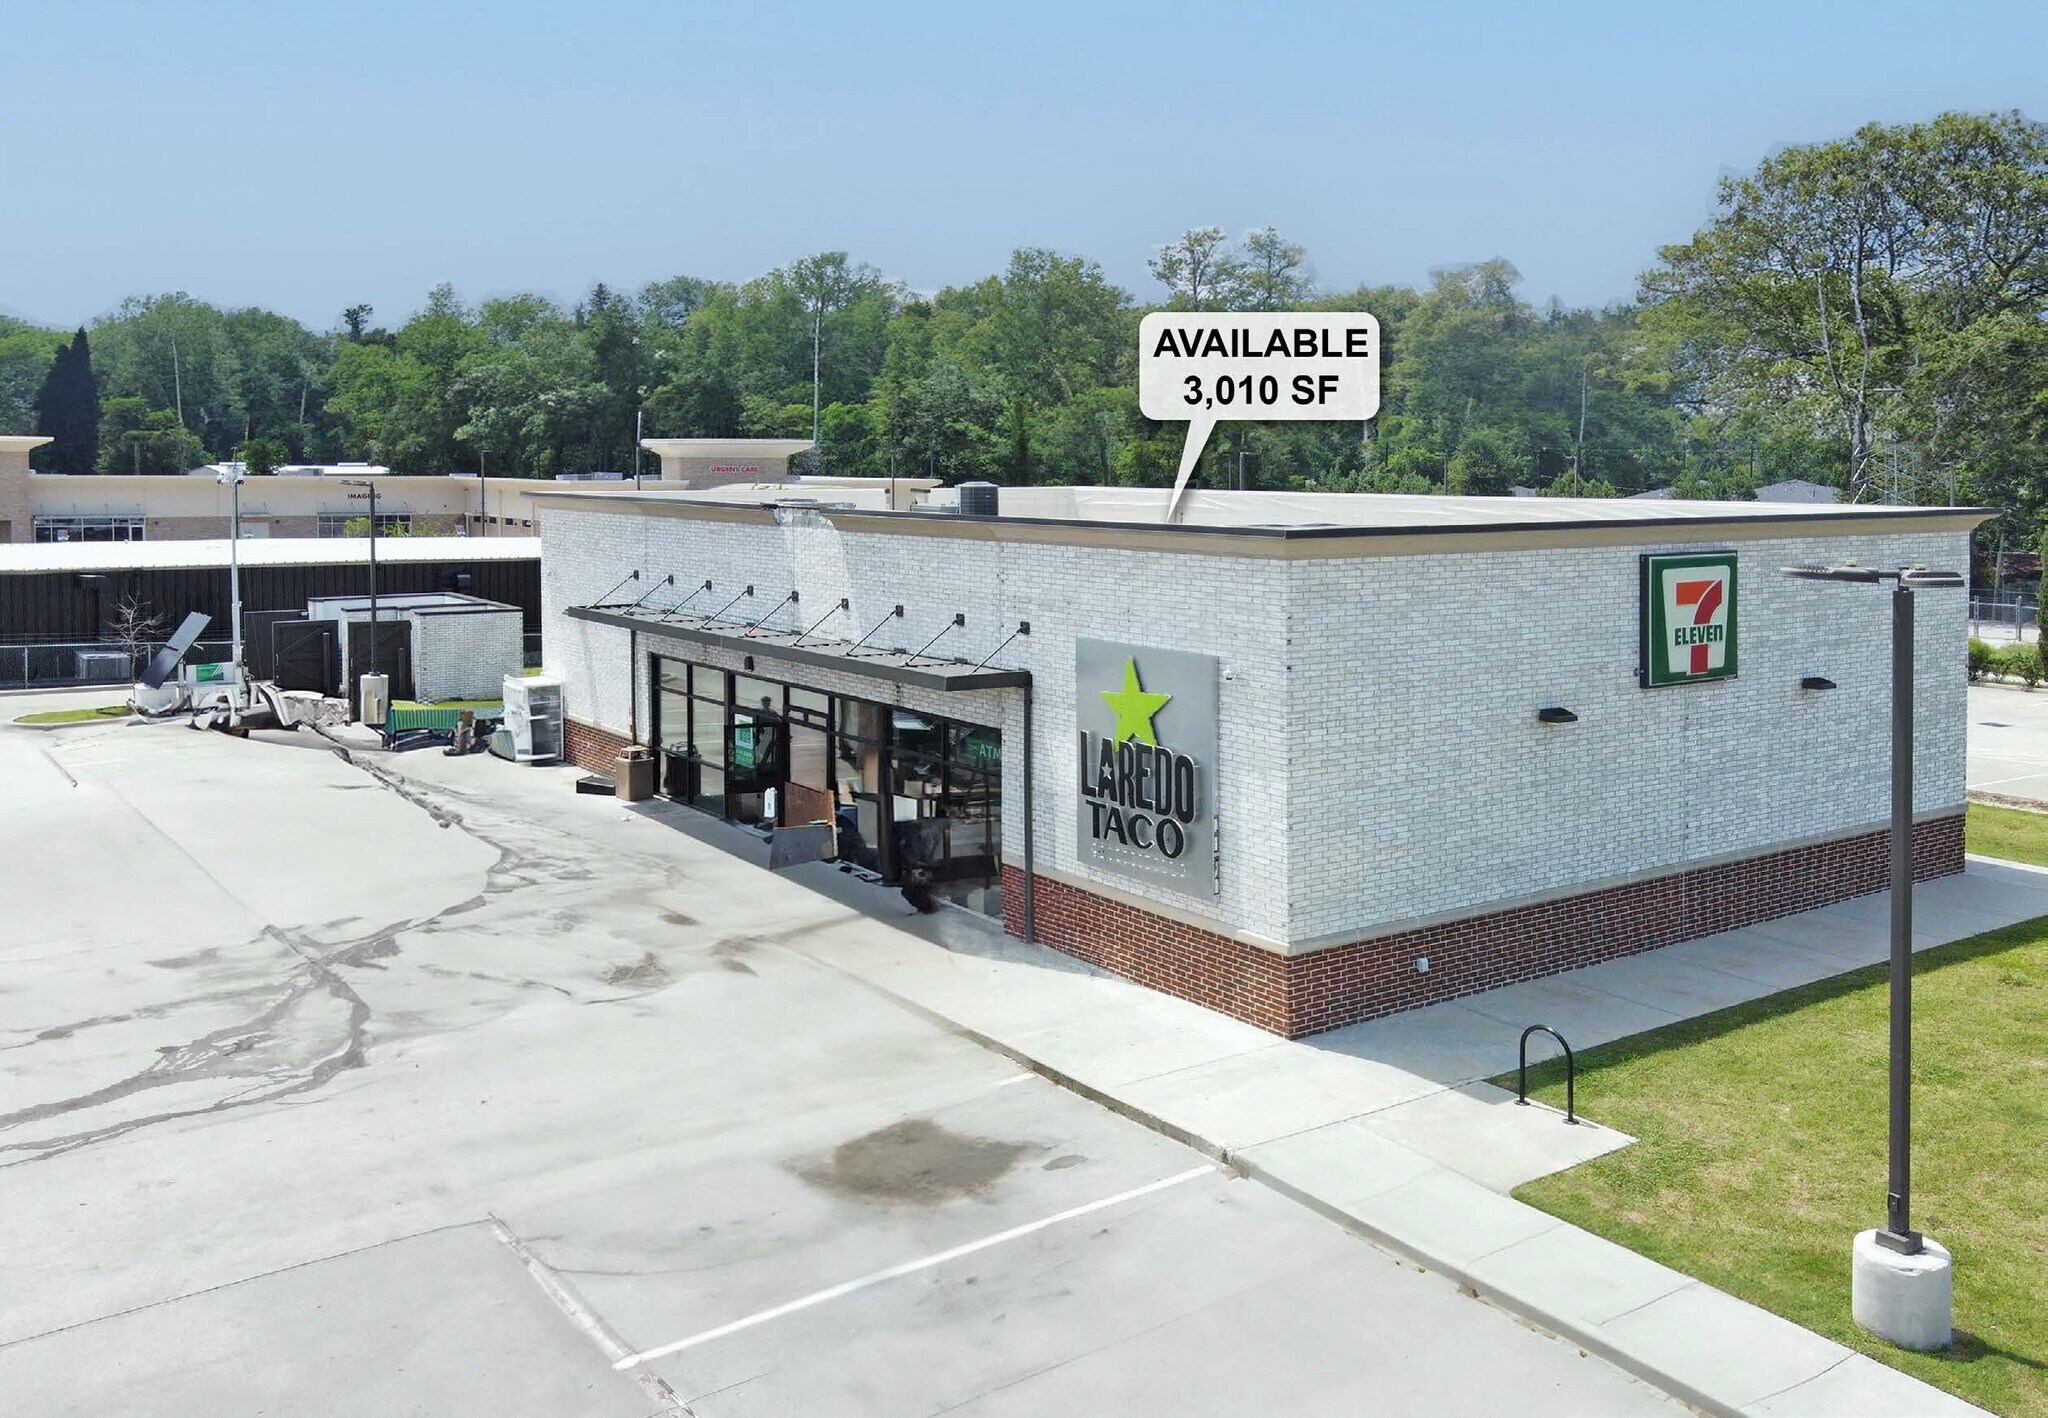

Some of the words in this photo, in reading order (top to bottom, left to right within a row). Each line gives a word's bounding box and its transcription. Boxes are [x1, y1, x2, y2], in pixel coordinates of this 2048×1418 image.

[710, 464, 739, 474] URGENT
[740, 465, 759, 475] CARE
[1675, 579, 1723, 674] 7
[979, 743, 1001, 760] ATM
[1080, 730, 1195, 824] LAREDO
[1085, 799, 1185, 858] TACO
